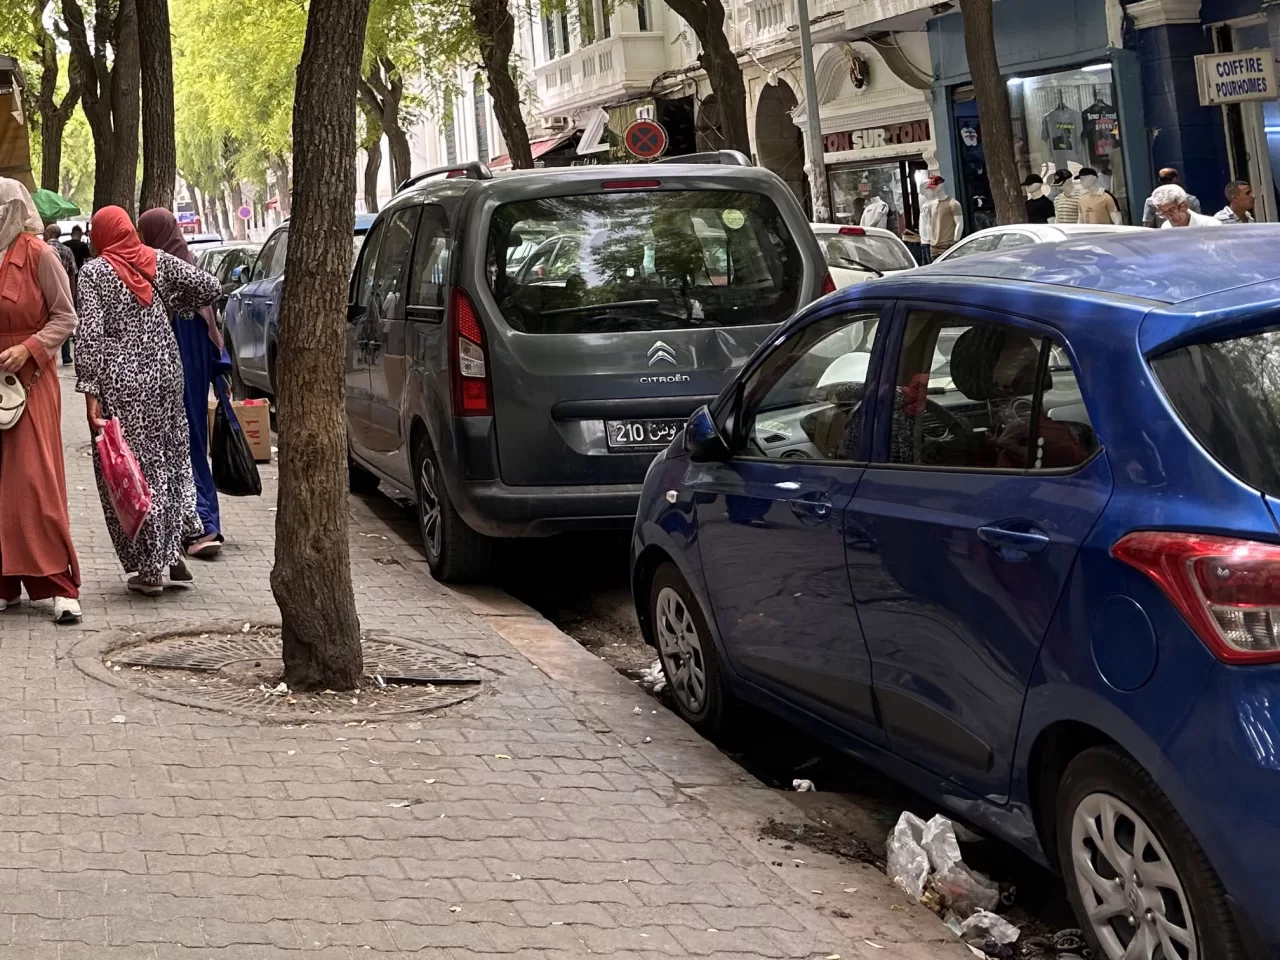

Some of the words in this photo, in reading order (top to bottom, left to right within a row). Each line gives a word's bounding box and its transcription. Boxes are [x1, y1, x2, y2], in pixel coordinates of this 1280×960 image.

[851, 128, 886, 151] SUR
[888, 123, 928, 145] TON
[616, 423, 645, 442] 210
[649, 422, 677, 441] تونس
